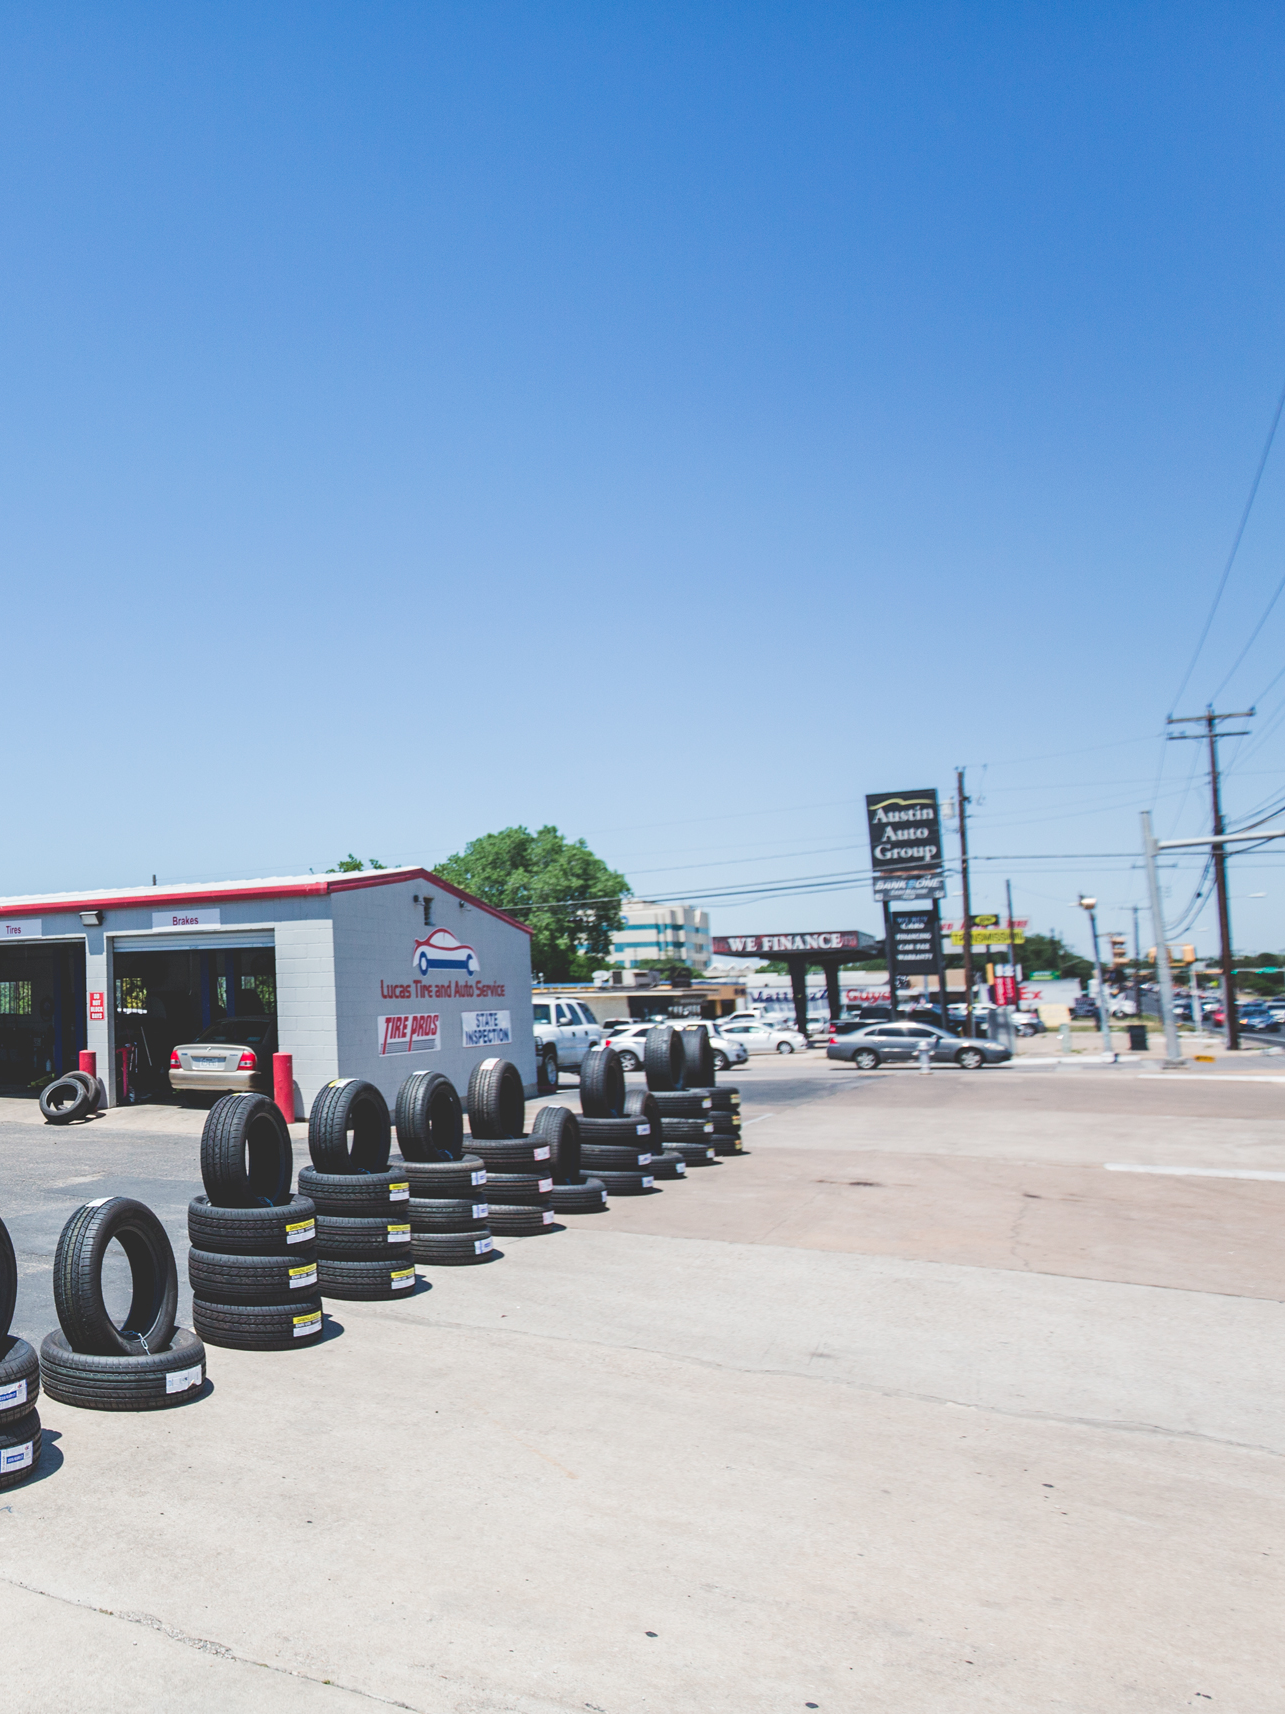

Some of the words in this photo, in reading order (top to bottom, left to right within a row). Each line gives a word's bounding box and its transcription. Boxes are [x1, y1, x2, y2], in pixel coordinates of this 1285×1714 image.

[872, 805, 934, 824] Austin
[881, 825, 929, 842] Auto
[873, 843, 937, 861] Group
[5, 925, 22, 935] Tires
[172, 916, 199, 926] Brakes
[727, 936, 758, 952] WE
[761, 933, 843, 951] FINANCE
[380, 979, 412, 999] Lucas
[413, 979, 433, 999] Tire
[434, 980, 452, 998] and
[454, 980, 474, 998] Auto
[475, 980, 506, 998] Service
[846, 988, 891, 1006] Guys
[475, 1012, 498, 1028] STATE
[382, 1015, 410, 1055] TIRE
[407, 1014, 440, 1052] PROS
[465, 1027, 511, 1046] INSPECTION
